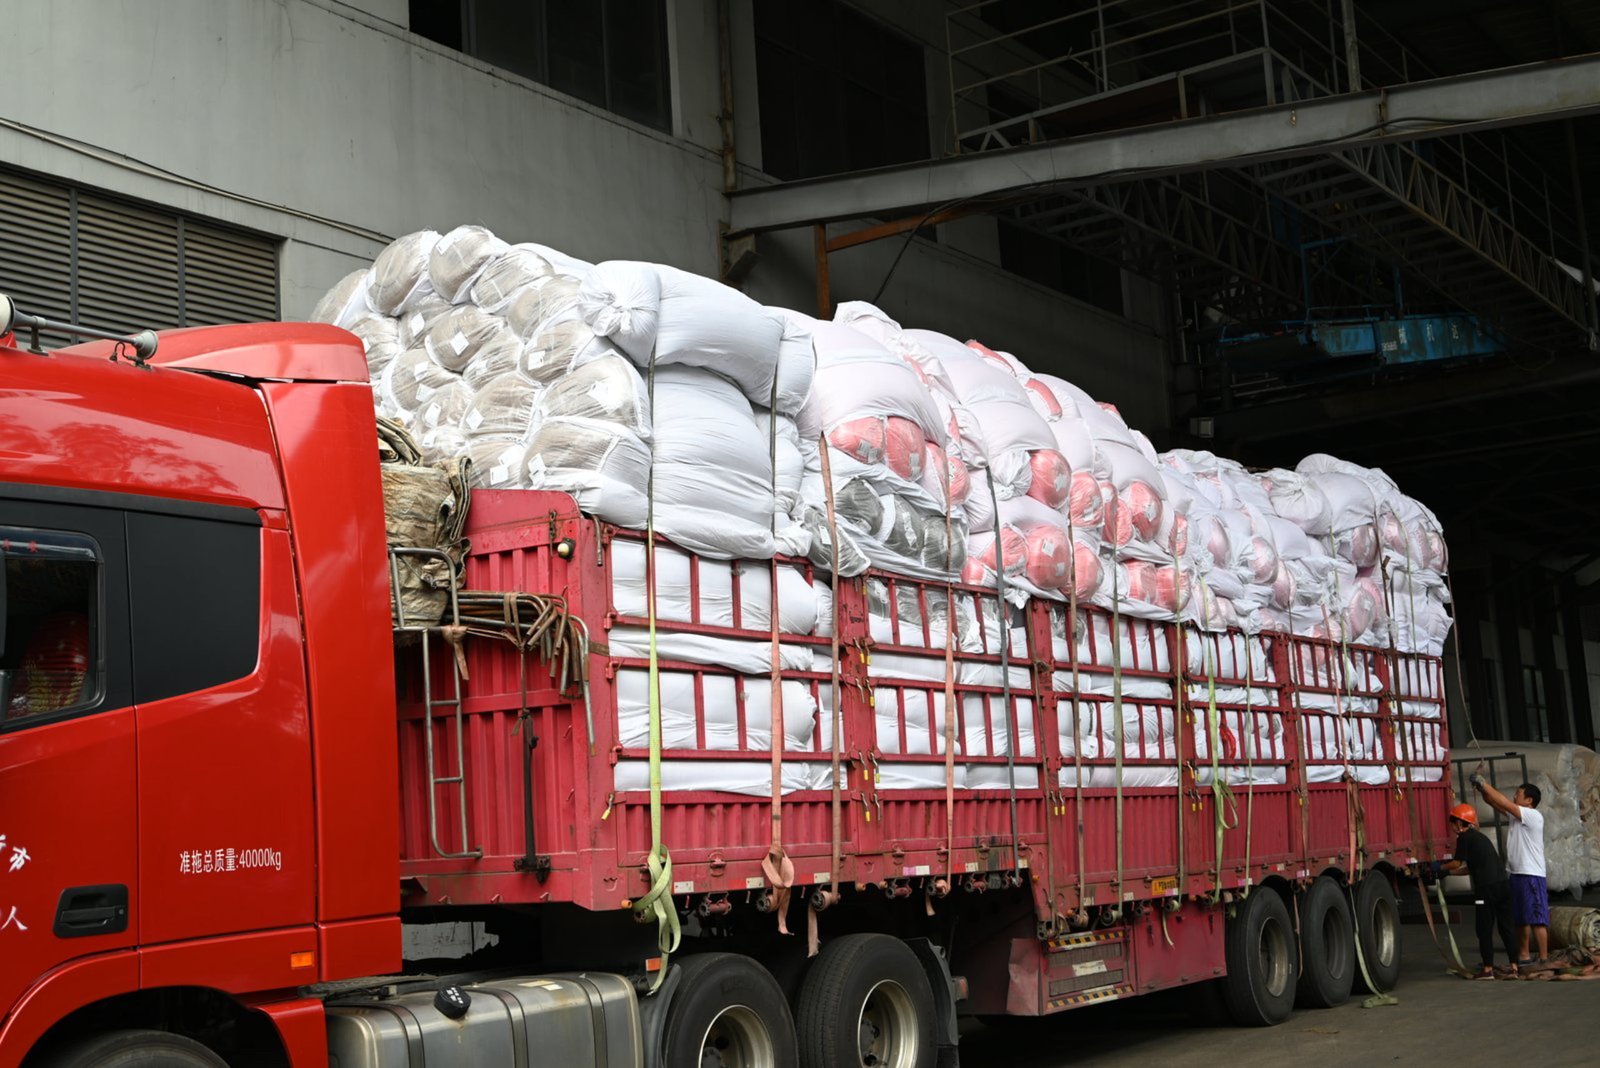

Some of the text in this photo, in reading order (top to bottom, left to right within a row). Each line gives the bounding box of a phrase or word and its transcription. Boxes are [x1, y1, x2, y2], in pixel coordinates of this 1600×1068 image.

[180, 848, 282, 874] 准拖总质量:40000kg
